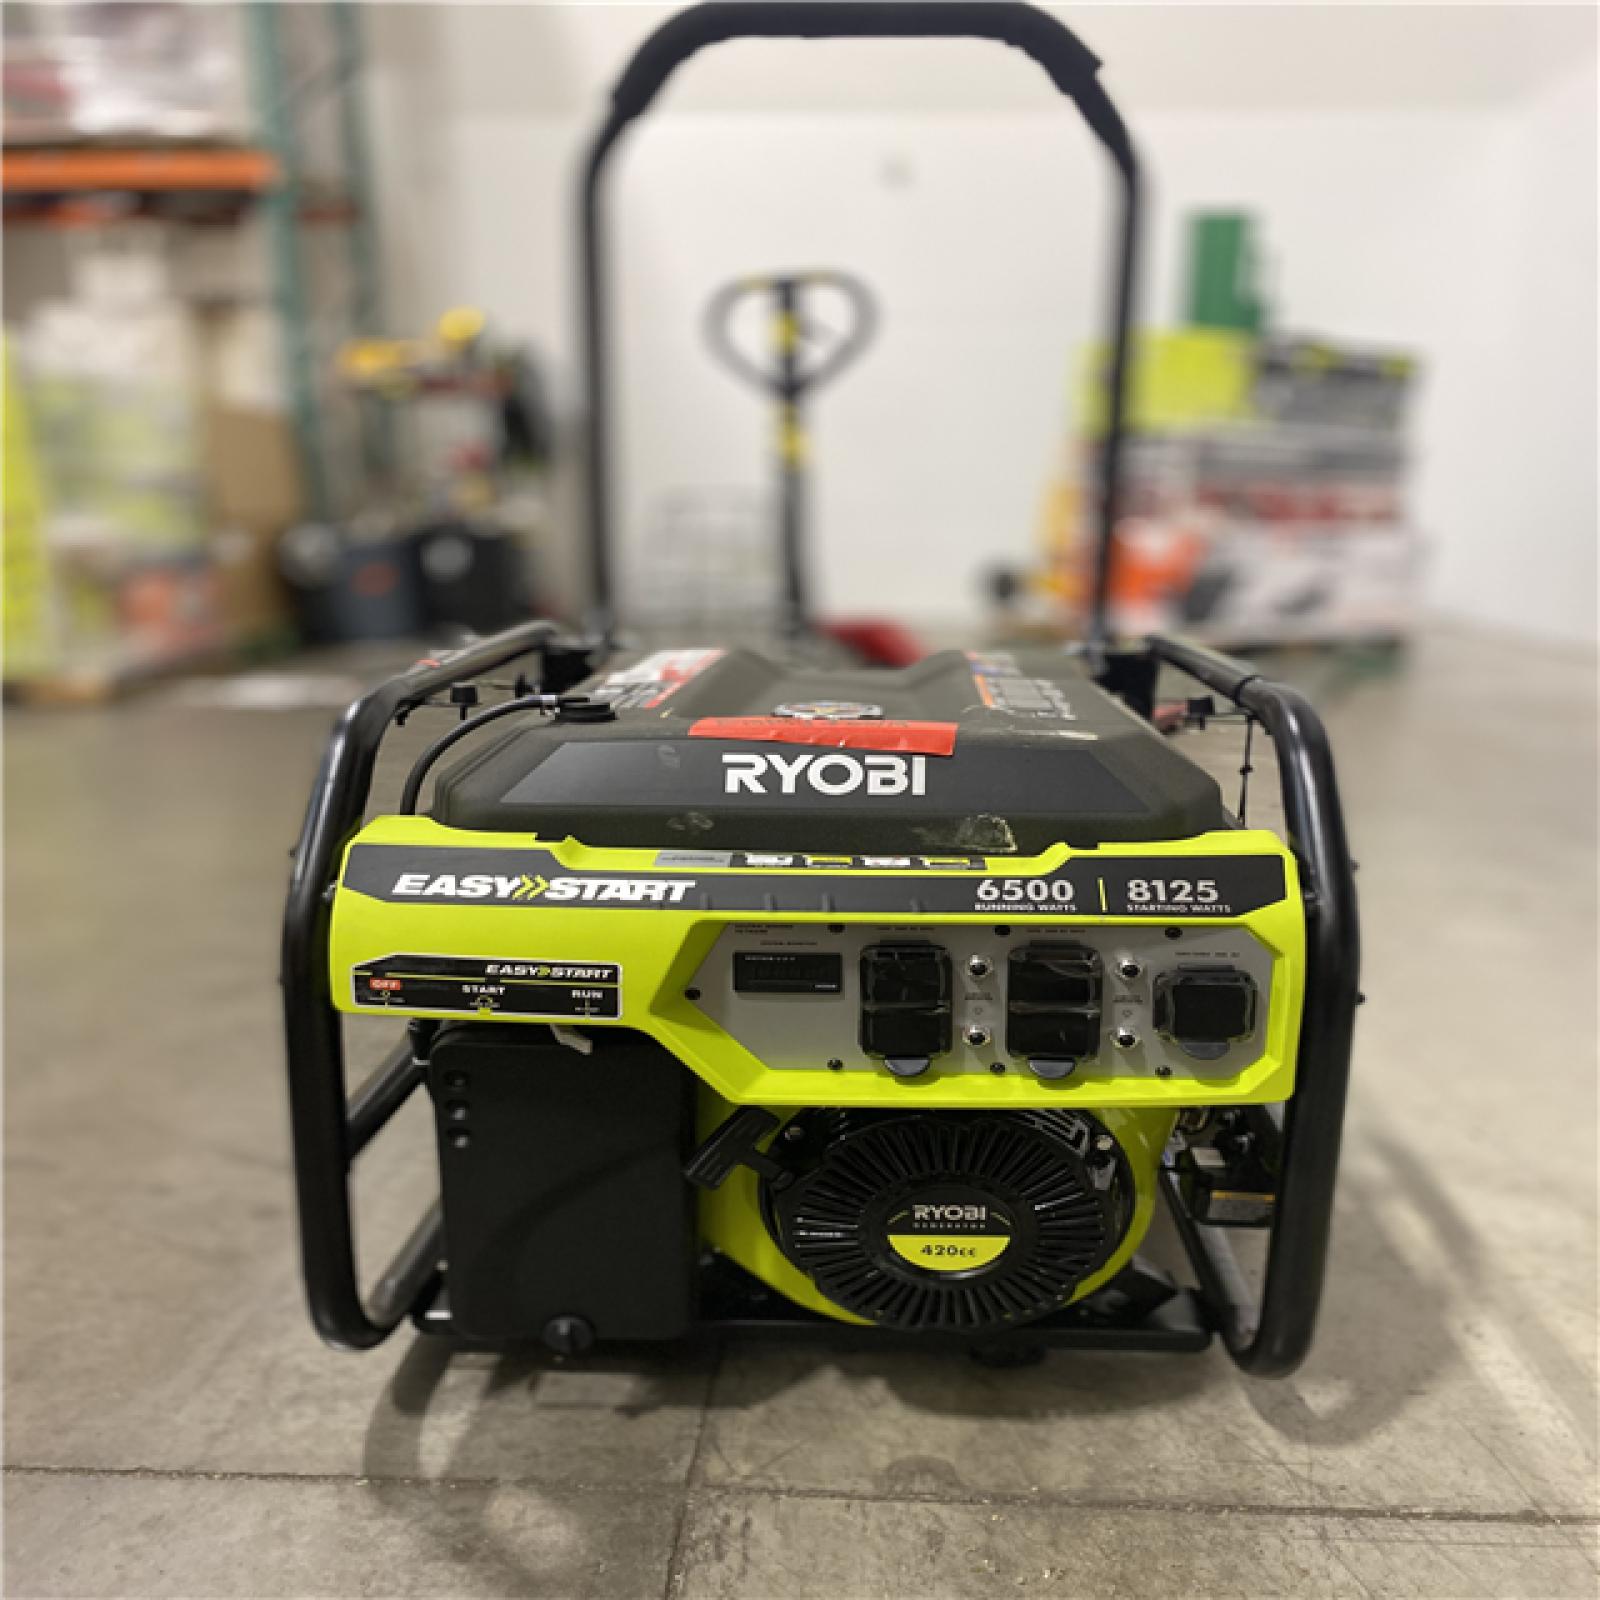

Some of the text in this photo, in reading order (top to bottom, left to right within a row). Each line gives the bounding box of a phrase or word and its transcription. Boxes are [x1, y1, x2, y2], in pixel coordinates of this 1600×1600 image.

[722, 754, 926, 796] RYOBI
[392, 874, 697, 902] EASY START
[976, 879, 1219, 902] 6500 8125
[485, 964, 614, 979] EASY START
[462, 985, 506, 995] START
[572, 989, 604, 999] RUN
[913, 1204, 986, 1221] RYOBI
